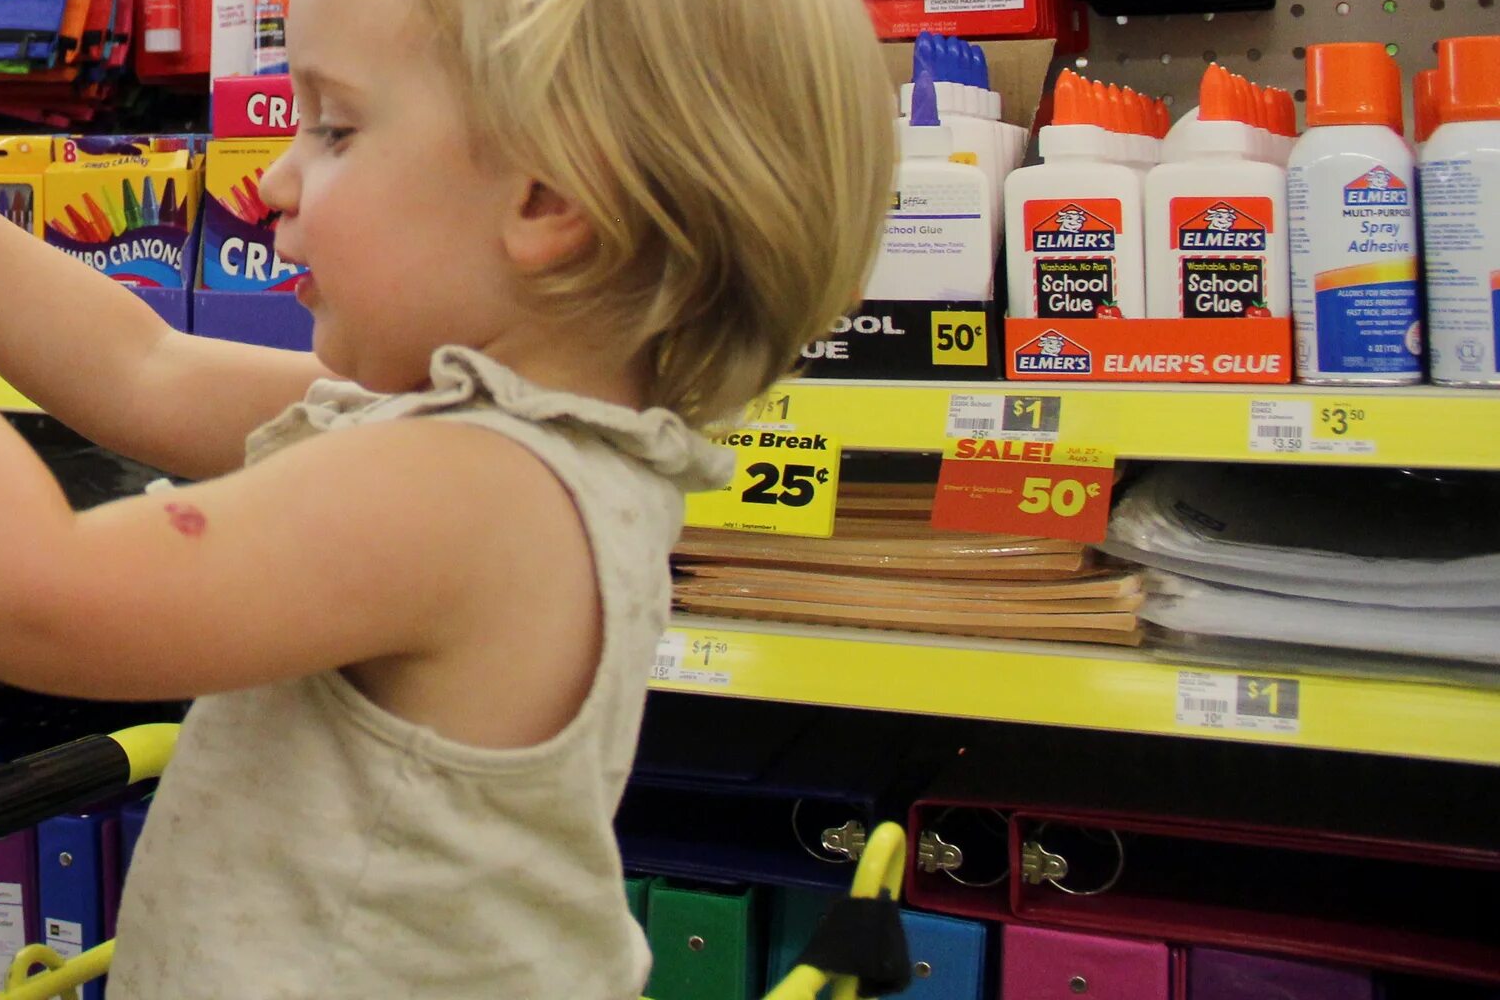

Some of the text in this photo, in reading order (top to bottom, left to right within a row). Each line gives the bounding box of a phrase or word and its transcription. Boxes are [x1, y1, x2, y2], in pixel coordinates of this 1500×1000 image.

[63, 140, 77, 164] 8
[1346, 190, 1407, 204] ELMER'S
[919, 226, 944, 235] Glue
[1182, 231, 1264, 247] ELMER'S
[1360, 221, 1401, 238] Spray
[1036, 232, 1112, 249] ELMER'S
[1347, 239, 1410, 253] Adhesive
[109, 238, 183, 270] CRAYONS
[1040, 262, 1108, 272] Washable, No Run
[1186, 261, 1258, 271] Washable, No Run
[1041, 273, 1108, 293] School
[1187, 274, 1258, 293] School
[1048, 293, 1094, 312] Glue
[1195, 293, 1243, 313] Glue
[936, 323, 982, 352] 50¢
[1019, 354, 1282, 374] ELMER'S ELMER'S GLUE
[1013, 400, 1042, 429] $1
[758, 432, 829, 450] Break
[954, 438, 1055, 463] SALE!
[741, 461, 830, 508] 25¢
[1017, 476, 1101, 518] 50¢
[1247, 680, 1278, 715] $1
